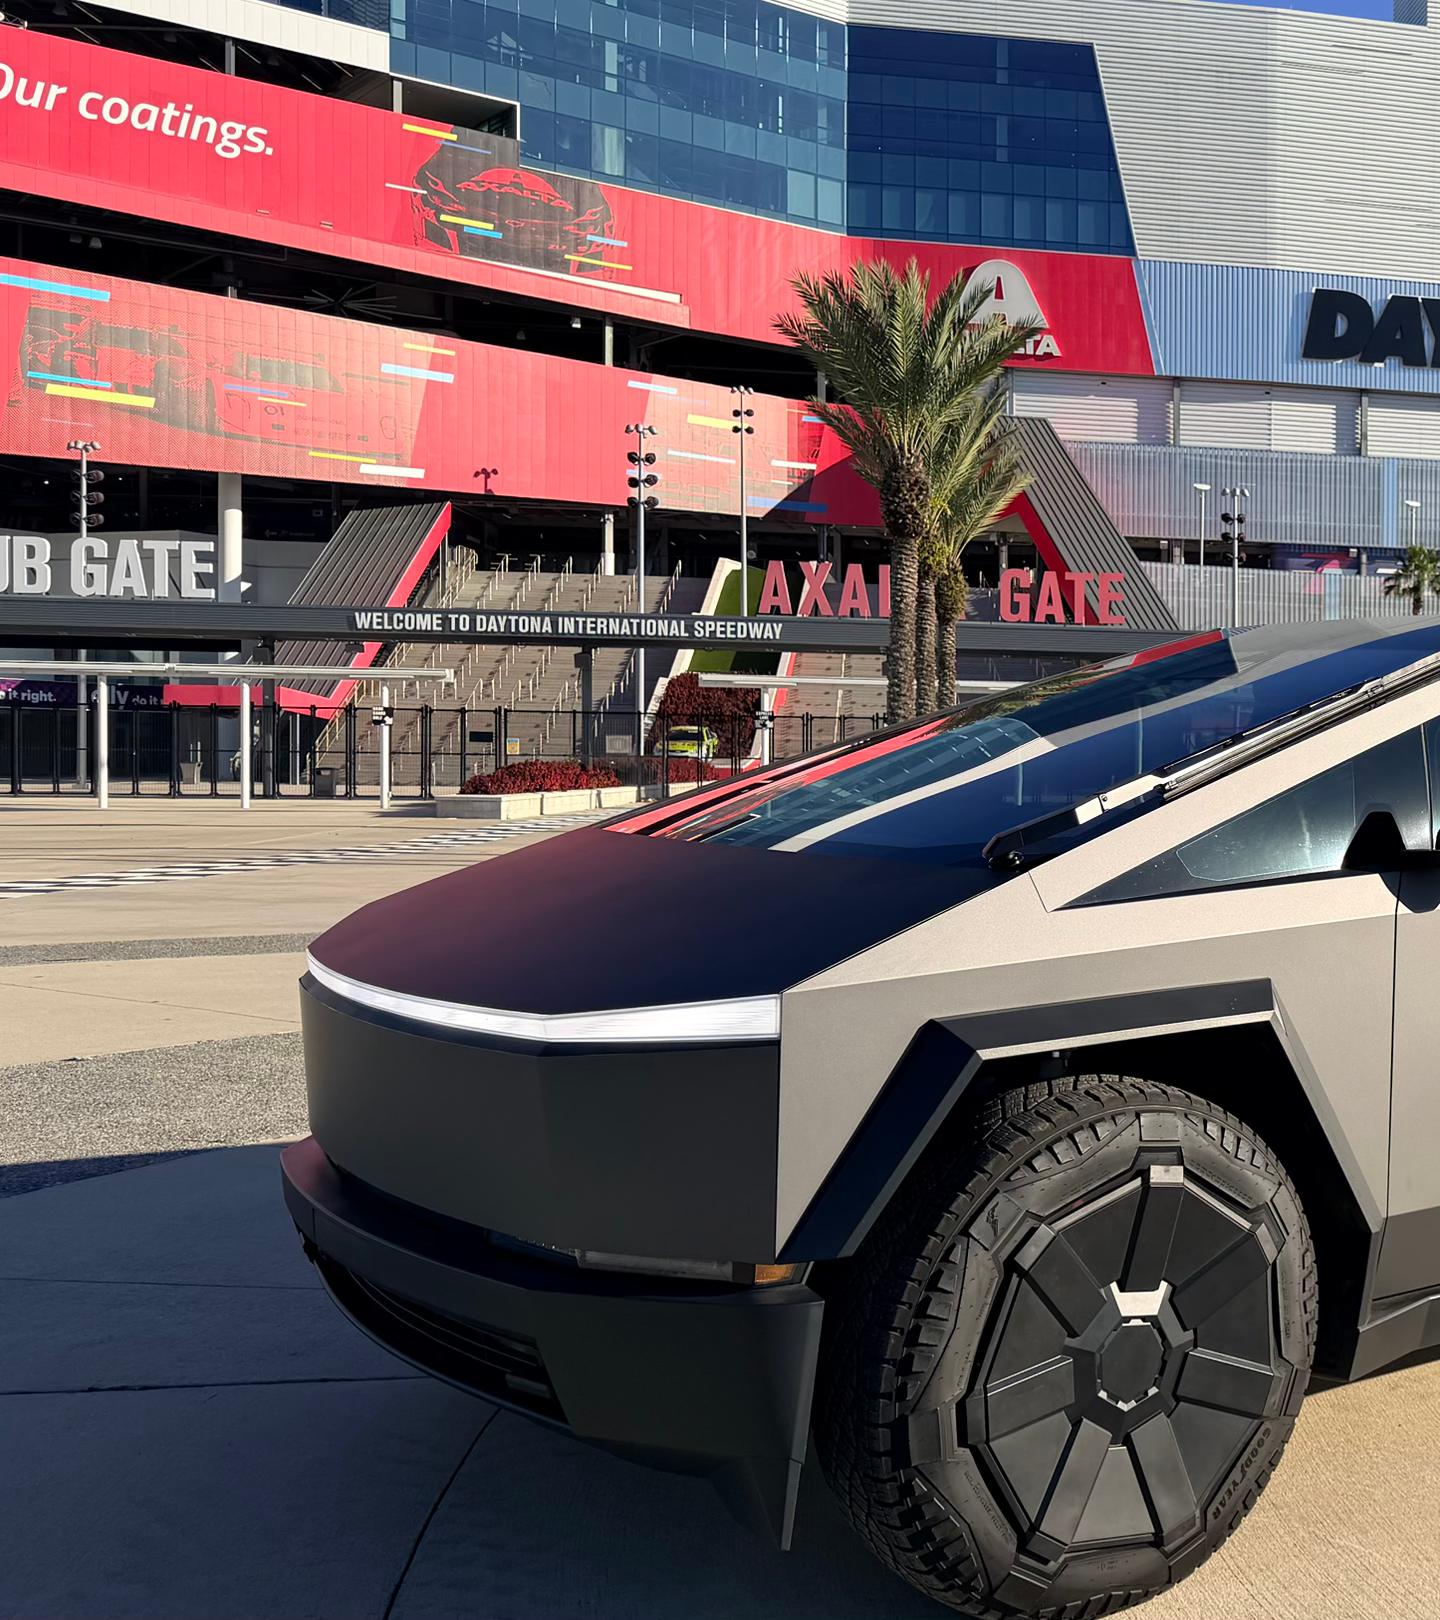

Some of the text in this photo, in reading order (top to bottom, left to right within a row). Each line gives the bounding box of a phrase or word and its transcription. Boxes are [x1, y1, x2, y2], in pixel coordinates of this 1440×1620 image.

[78, 91, 274, 159] coatings.
[71, 537, 216, 598] GATE
[999, 568, 1127, 625] GATE
[355, 611, 783, 640] WELCOME TO DAYTONA INTERNATIONAL SPEEDWAY
[21, 689, 57, 704] right.
[1211, 1426, 1272, 1523] GOODYEAR
